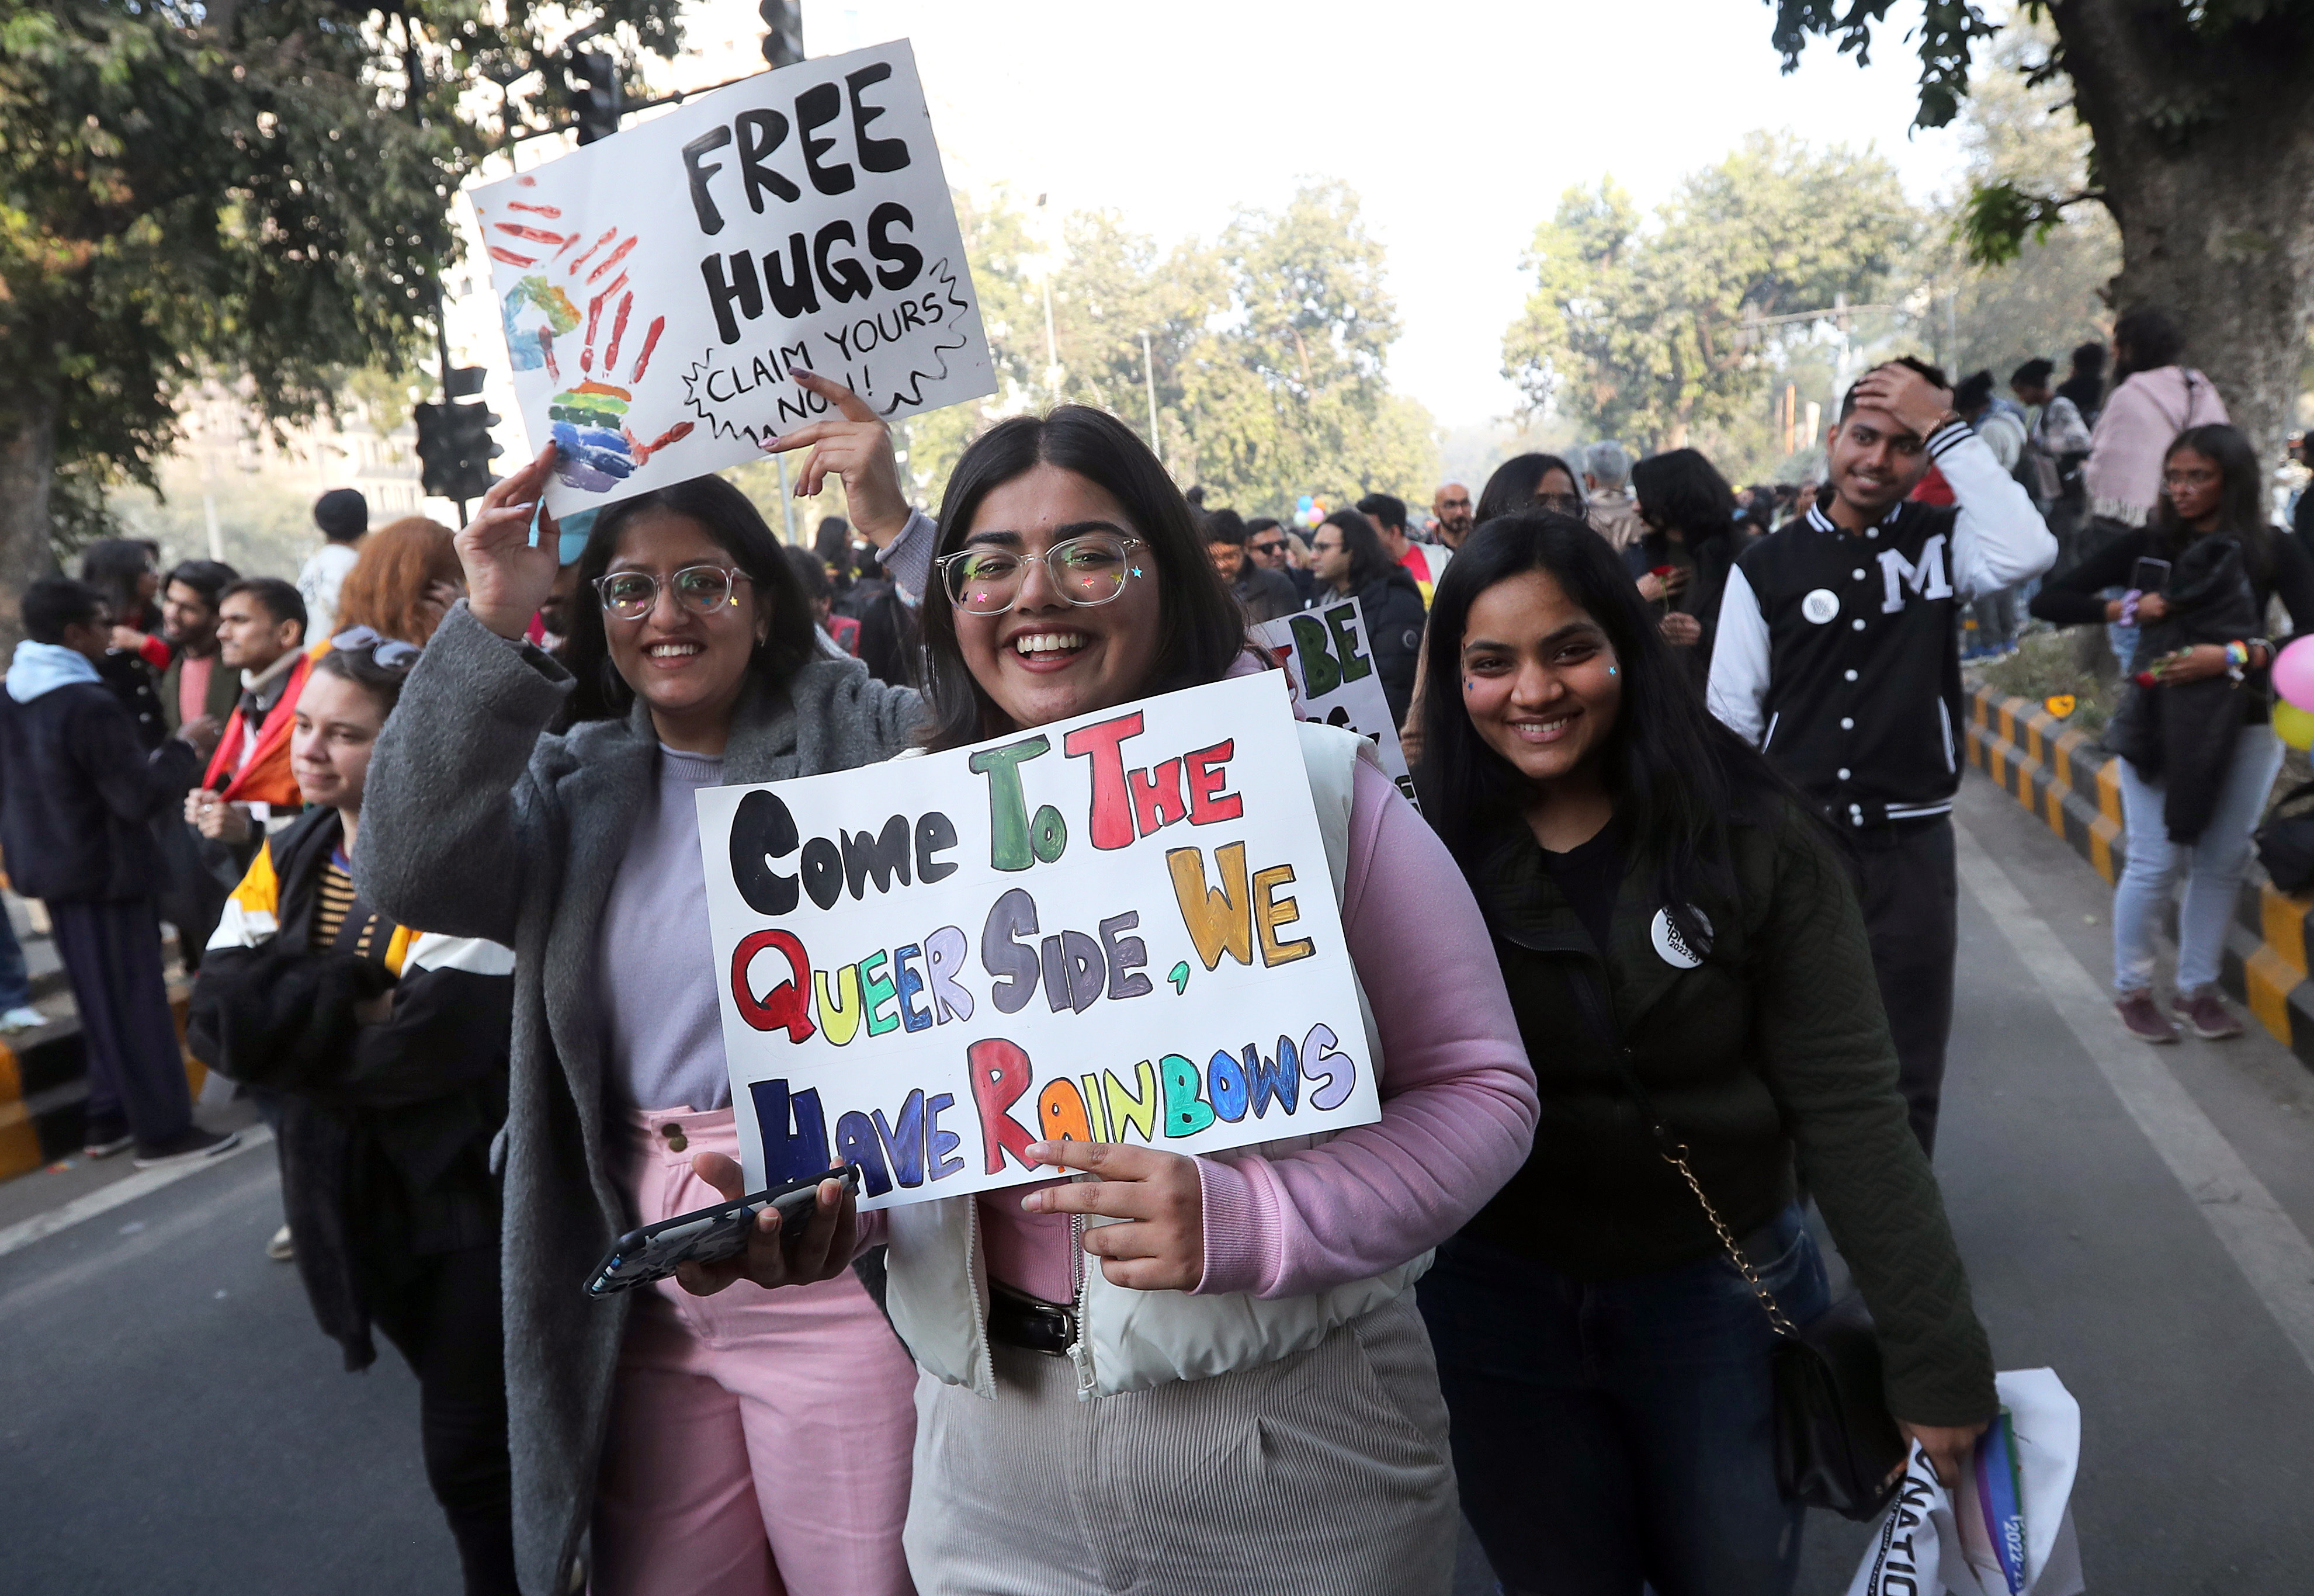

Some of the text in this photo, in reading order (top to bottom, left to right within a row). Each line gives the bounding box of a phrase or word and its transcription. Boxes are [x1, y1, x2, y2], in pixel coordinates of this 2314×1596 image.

[682, 62, 911, 235] FREE
[701, 202, 923, 344] HUGS
[706, 292, 944, 402] CLAIM YOURS
[1875, 532, 1954, 613] M
[1289, 602, 1372, 700] BE
[731, 925, 974, 1047] QUEER
[1165, 841, 1316, 972] WE
[748, 1023, 1356, 1198] HAVE RAINBOWS
